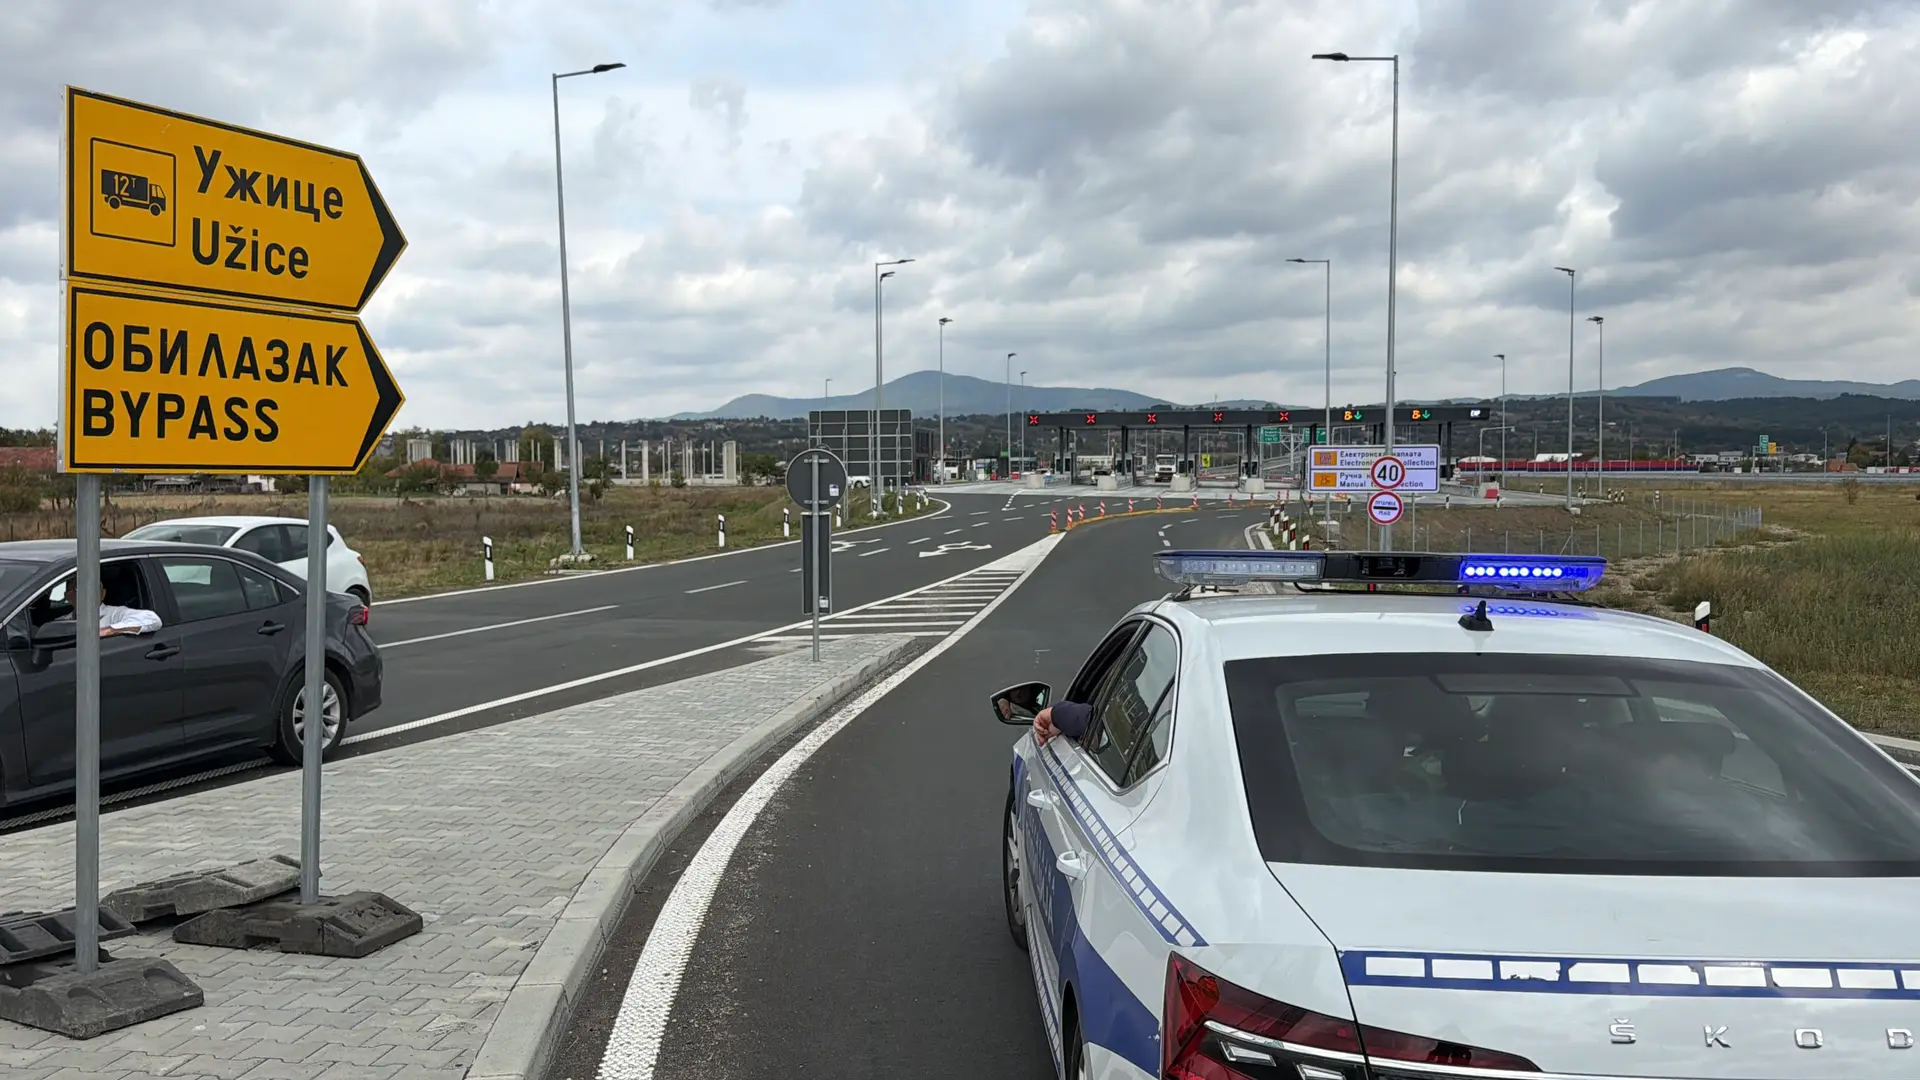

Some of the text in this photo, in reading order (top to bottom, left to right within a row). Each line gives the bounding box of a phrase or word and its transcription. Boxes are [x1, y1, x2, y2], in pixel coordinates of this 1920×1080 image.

[193, 145, 343, 223] Ужице
[192, 217, 309, 279] Užice
[83, 321, 349, 387] ОБИЛАЗАК
[82, 388, 280, 443] BYPASS
[1377, 464, 1399, 481] 40
